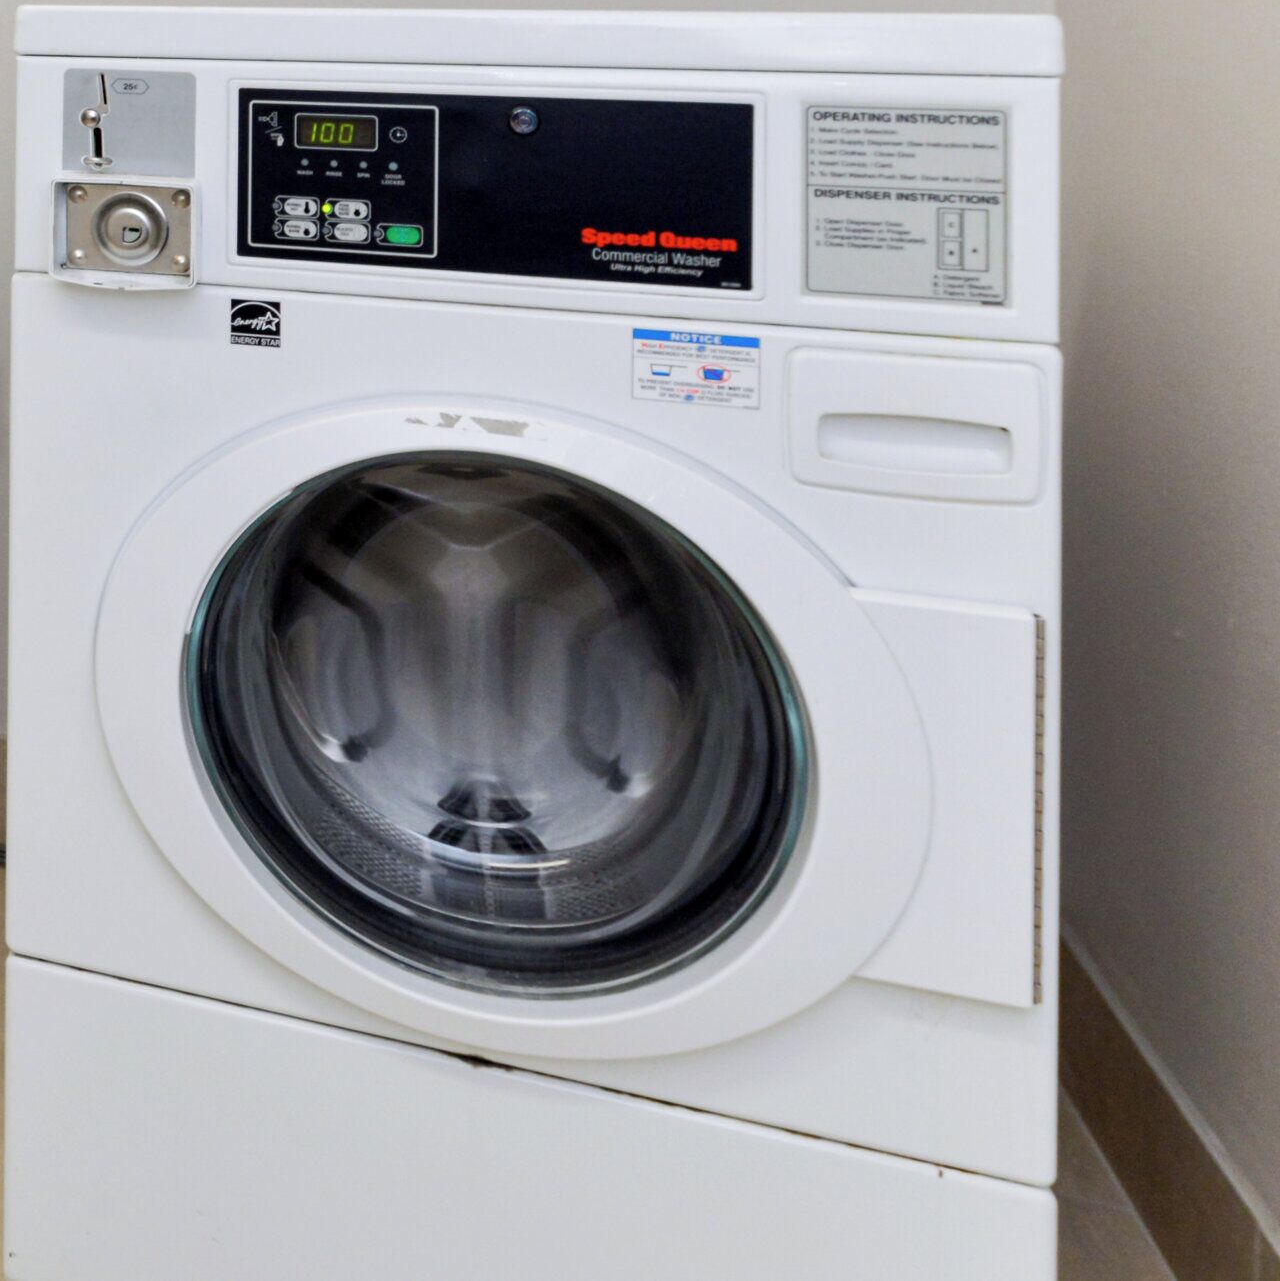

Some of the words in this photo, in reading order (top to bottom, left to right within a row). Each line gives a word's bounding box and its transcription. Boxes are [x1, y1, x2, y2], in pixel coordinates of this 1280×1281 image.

[813, 111, 891, 123] OPERATING
[896, 114, 1000, 126] INSTRUCTIONS
[311, 122, 354, 144] 100
[814, 189, 891, 200] DISPENSER
[896, 192, 1000, 205] INSTRUCTIONS
[581, 228, 656, 247] Speed
[659, 231, 737, 252] Queen
[592, 247, 668, 264] Commercial
[671, 253, 722, 267] Washer
[610, 263, 631, 271] Ultra
[634, 265, 655, 273] High
[658, 266, 703, 277] Efficiency
[231, 336, 259, 345] ENERGY
[261, 338, 280, 346] STAR
[670, 333, 722, 344] NOTICE
